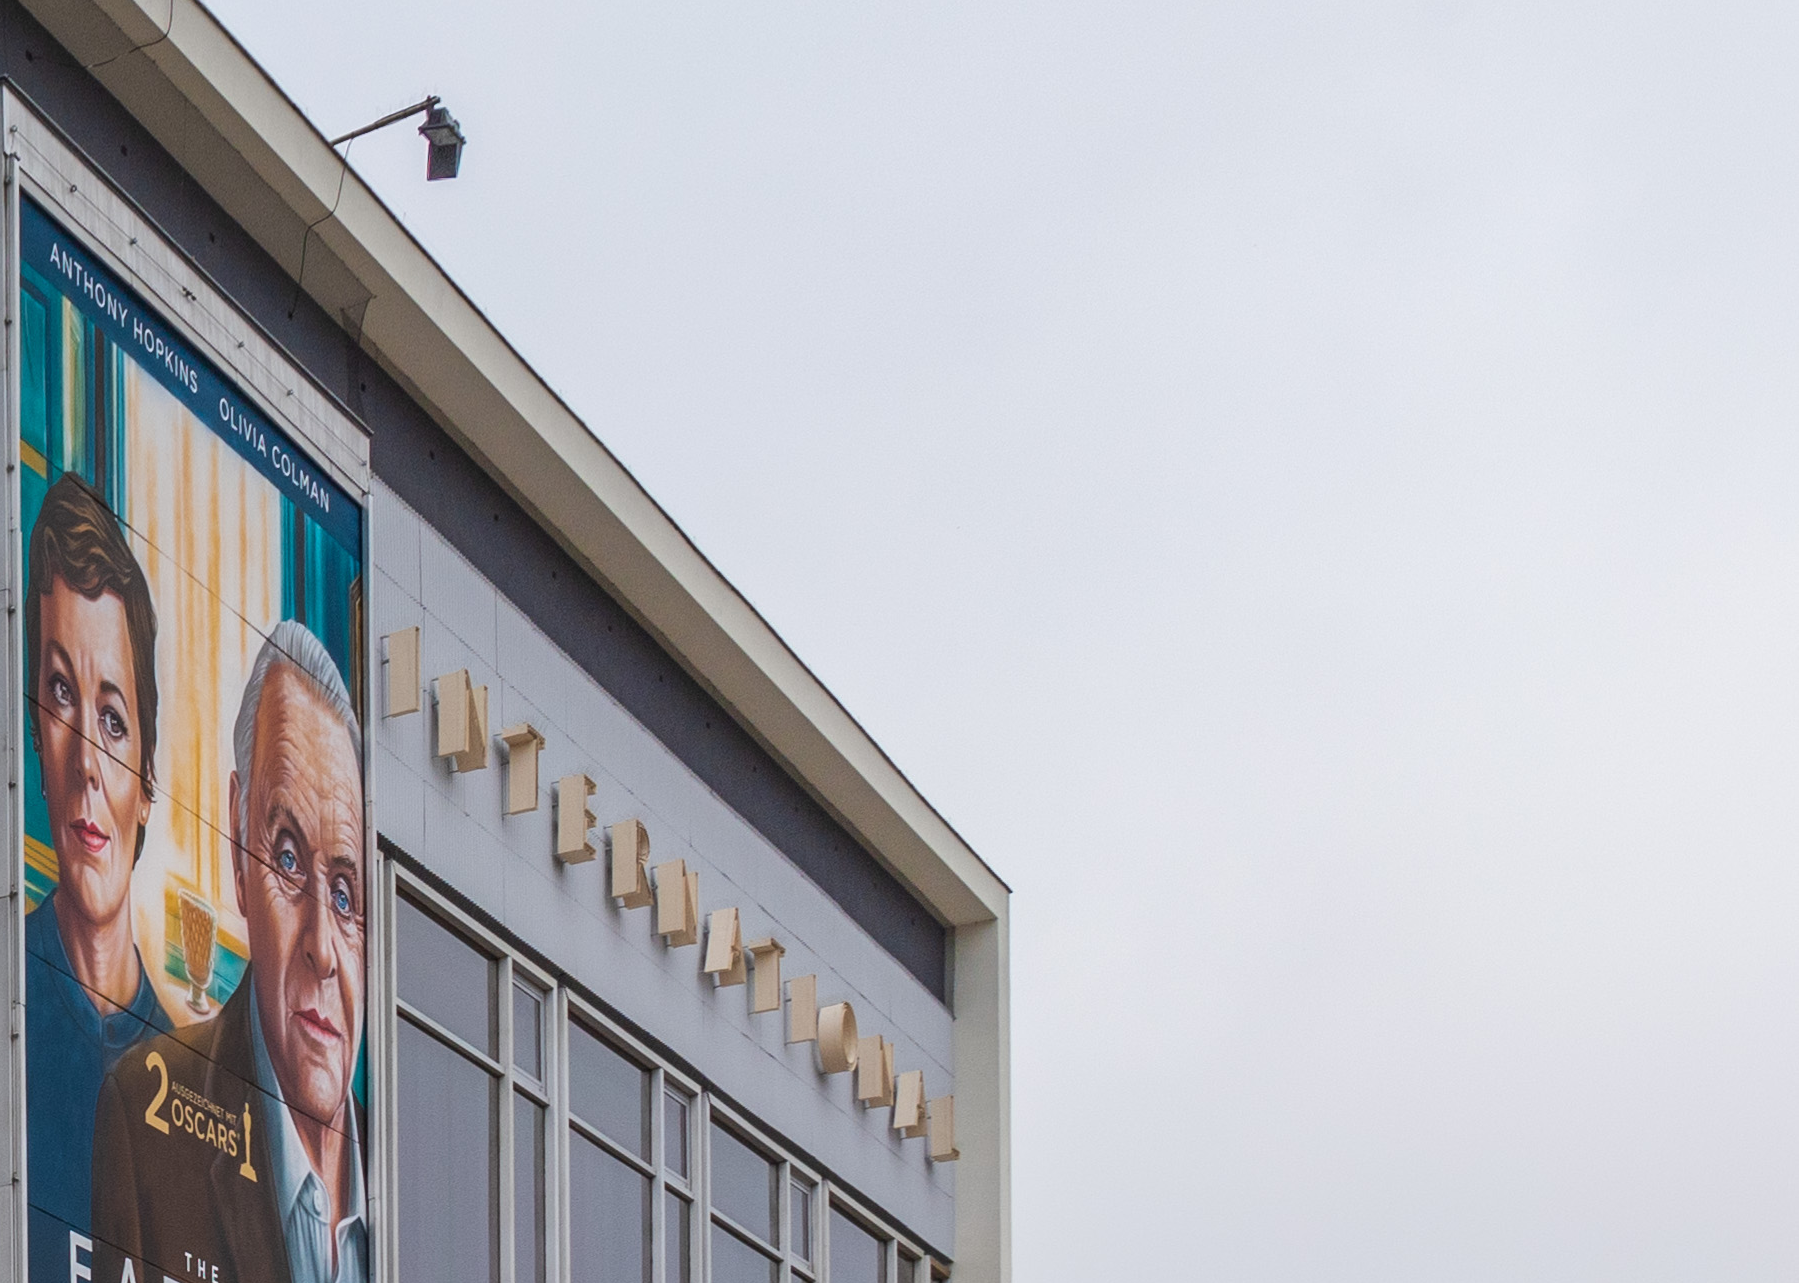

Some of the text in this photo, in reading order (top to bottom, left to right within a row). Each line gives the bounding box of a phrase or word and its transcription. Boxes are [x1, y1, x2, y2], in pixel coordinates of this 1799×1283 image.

[50, 243, 329, 513] ANTHONY HOPKINS OLIVIA COLMAN
[387, 626, 960, 1163] INTERNATIONAL
[145, 1051, 170, 1135] 2
